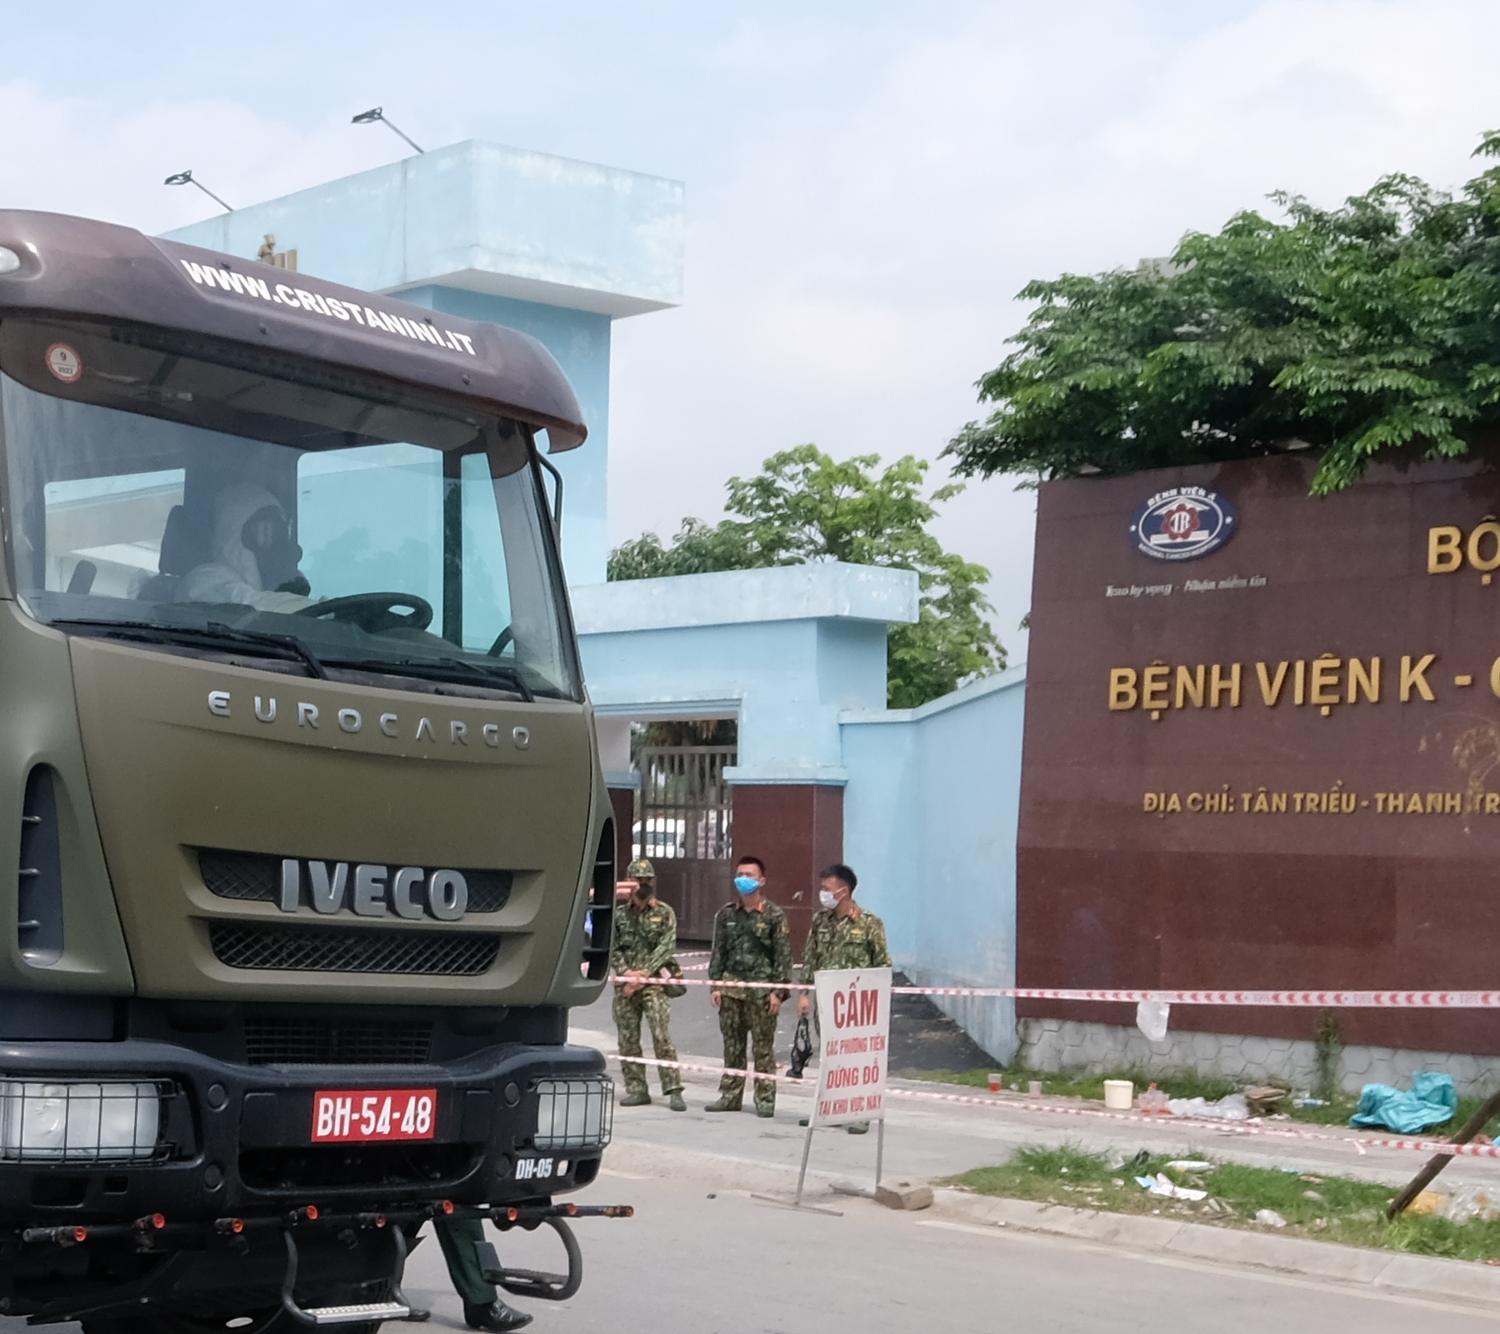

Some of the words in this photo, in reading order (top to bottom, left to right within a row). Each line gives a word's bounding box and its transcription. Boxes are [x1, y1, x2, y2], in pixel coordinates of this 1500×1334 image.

[180, 259, 476, 356] WWW.CRISTANINI.IT
[1109, 659, 1241, 720] BỆNH
[1256, 652, 1380, 716] VIỆN
[1399, 653, 1438, 702] K
[1454, 673, 1472, 686] -
[208, 689, 530, 749] EUROCARGO
[1143, 792, 1182, 818] ĐỊA
[1186, 784, 1235, 813] CHỈ:
[1241, 786, 1288, 813] TÂN
[1375, 792, 1462, 814] THANH
[281, 859, 468, 921] IVECO
[833, 976, 879, 1029] CẤM
[317, 1096, 432, 1137] BH-54-48
[515, 1158, 554, 1180] DH-05
